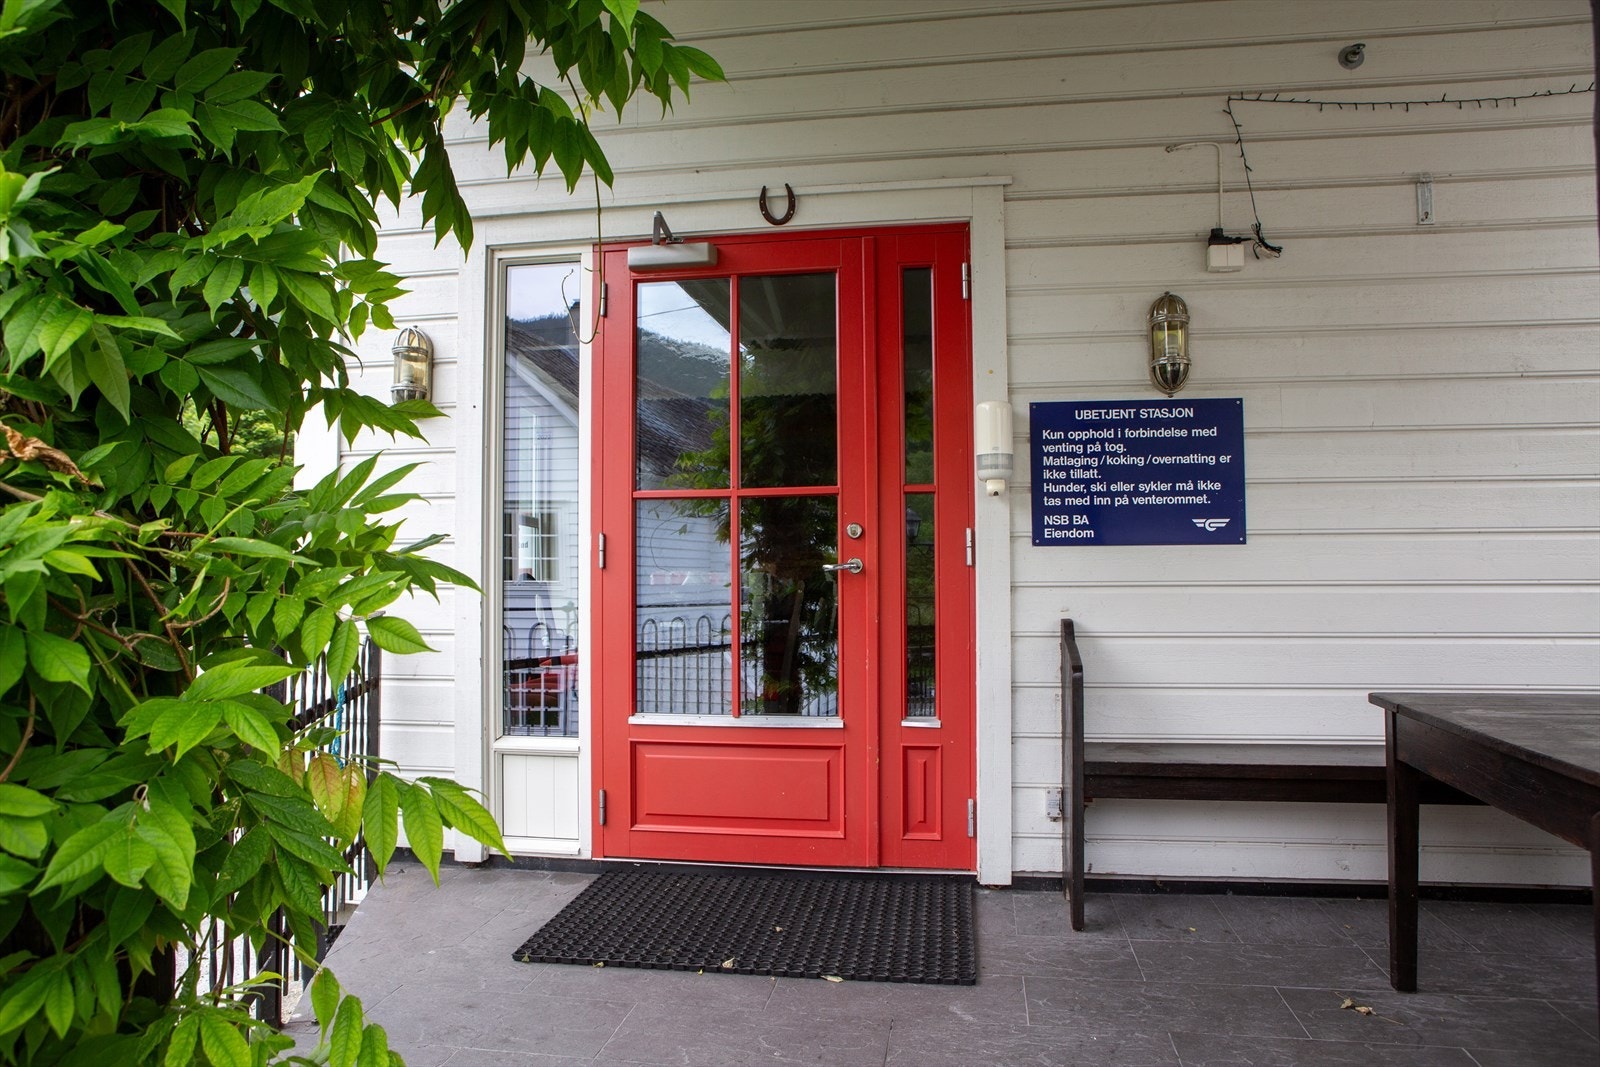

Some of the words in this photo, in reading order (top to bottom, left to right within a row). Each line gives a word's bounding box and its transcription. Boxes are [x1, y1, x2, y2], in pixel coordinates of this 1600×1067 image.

[1075, 408, 1137, 421] UBETJENT
[1139, 407, 1194, 420] STASJON
[1042, 429, 1065, 440] Kun
[1067, 428, 1115, 442] opphold
[1117, 428, 1121, 439] i
[1124, 426, 1188, 439] forbindelse
[1191, 426, 1218, 438] med
[1042, 441, 1084, 455] venting
[1086, 441, 1102, 455] på
[1104, 441, 1128, 454] tog.
[1219, 454, 1232, 464] er
[1043, 468, 1067, 480] ikke
[1069, 467, 1103, 479] tillatt.
[1043, 481, 1087, 495] Hunder,
[1090, 481, 1107, 492] ski
[1109, 481, 1136, 492] eller
[1137, 480, 1173, 494] sykler
[1175, 479, 1194, 491] må
[1197, 479, 1222, 491] ikke
[1043, 495, 1062, 506] tas
[1064, 494, 1091, 506] med
[1093, 494, 1111, 506] inn
[1113, 494, 1130, 508] på
[1131, 493, 1211, 506] venterommet.
[1043, 514, 1070, 526] NSB
[1072, 514, 1090, 525] BA
[1044, 527, 1095, 540] Eiendom
